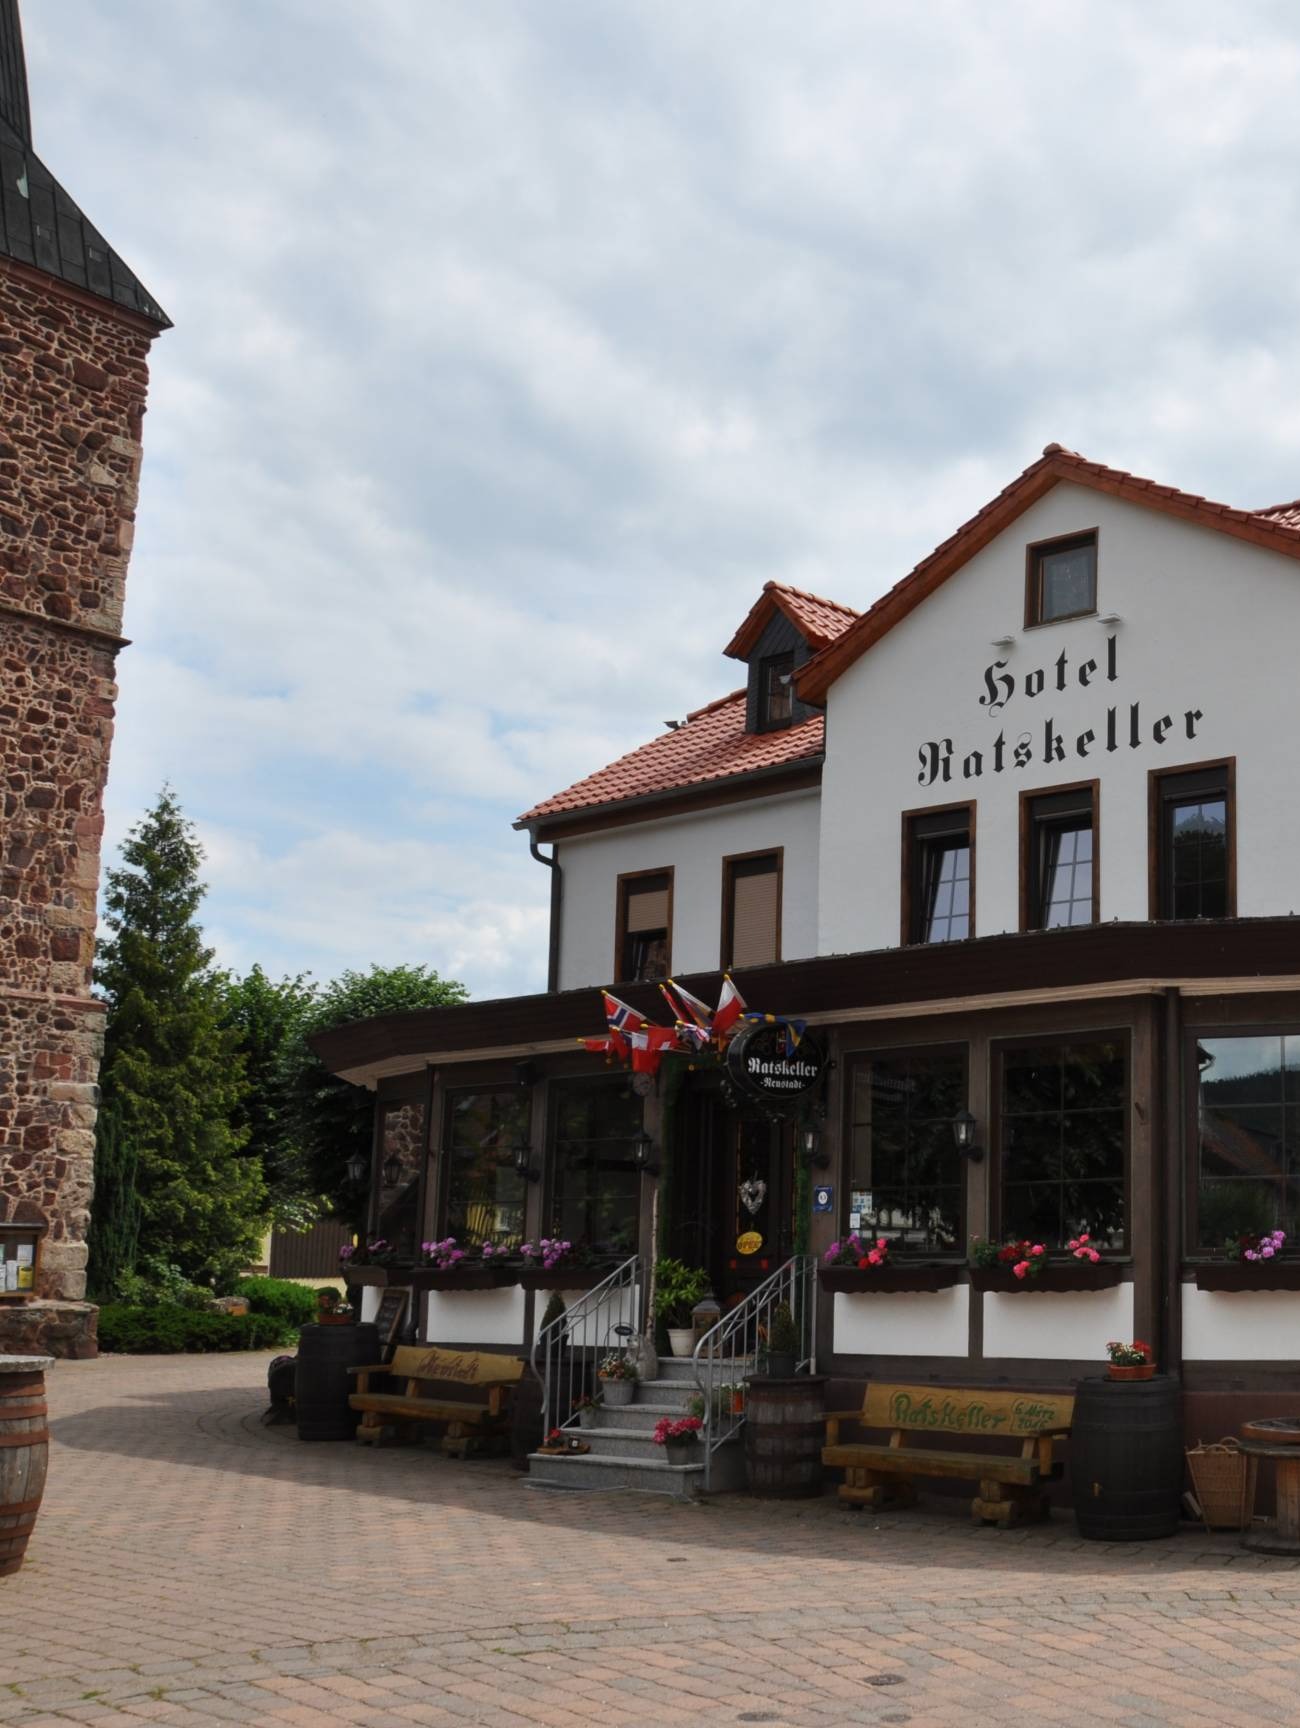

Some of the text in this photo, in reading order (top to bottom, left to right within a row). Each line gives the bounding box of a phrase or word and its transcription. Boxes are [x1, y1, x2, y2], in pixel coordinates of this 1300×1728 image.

[979, 634, 1118, 718] Hotel
[917, 701, 1203, 787] Ratskeller
[748, 1057, 818, 1076] Ratskeller
